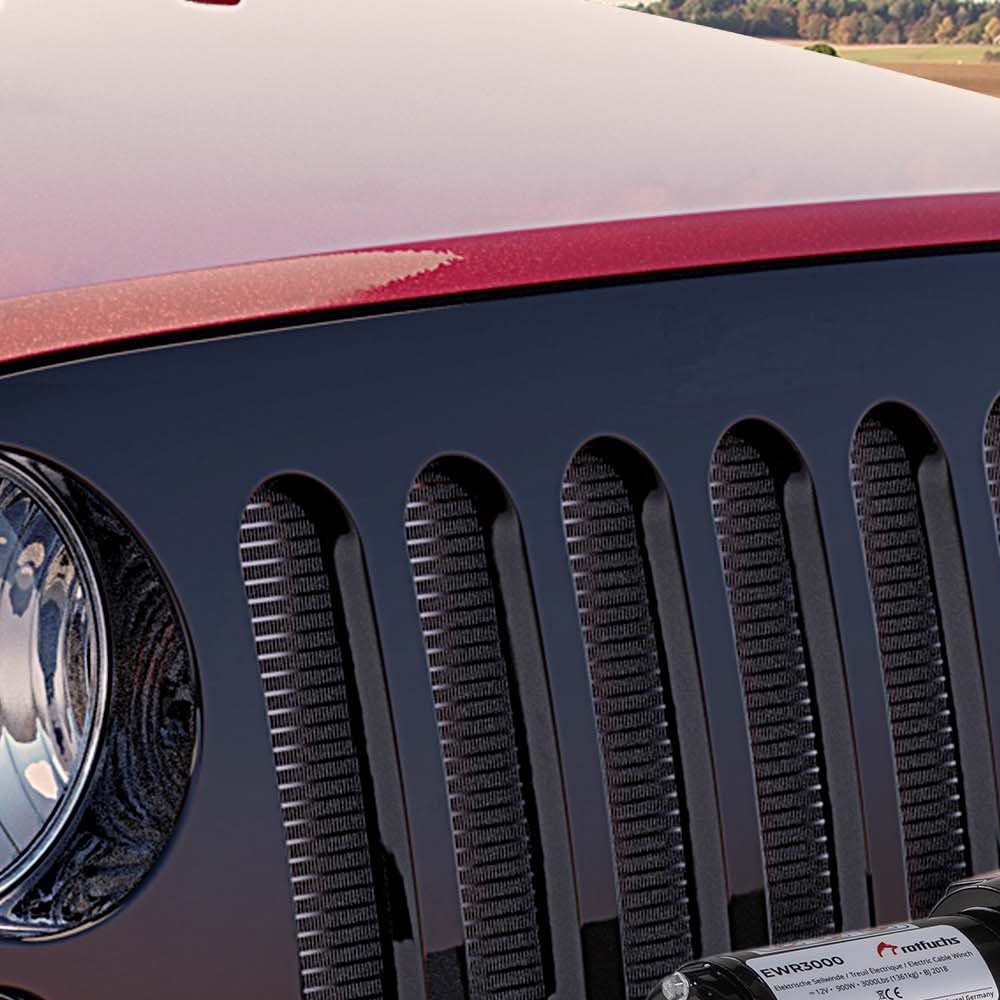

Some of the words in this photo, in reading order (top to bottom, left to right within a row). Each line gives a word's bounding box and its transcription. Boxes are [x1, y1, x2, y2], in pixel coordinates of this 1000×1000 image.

[901, 936, 961, 954] rotfuchs
[760, 956, 845, 978] EWR3000
[774, 979, 812, 991] Elektrische
[812, 974, 844, 986] Seilwinde
[849, 968, 869, 978] Treuil
[907, 957, 932, 968] Electric
[932, 954, 951, 963] Cable
[951, 950, 974, 960] Winch
[836, 982, 856, 991] 900W
[862, 977, 890, 988] 3000Lbs
[890, 971, 919, 983] (1361kg)
[931, 965, 950, 975] 2018
